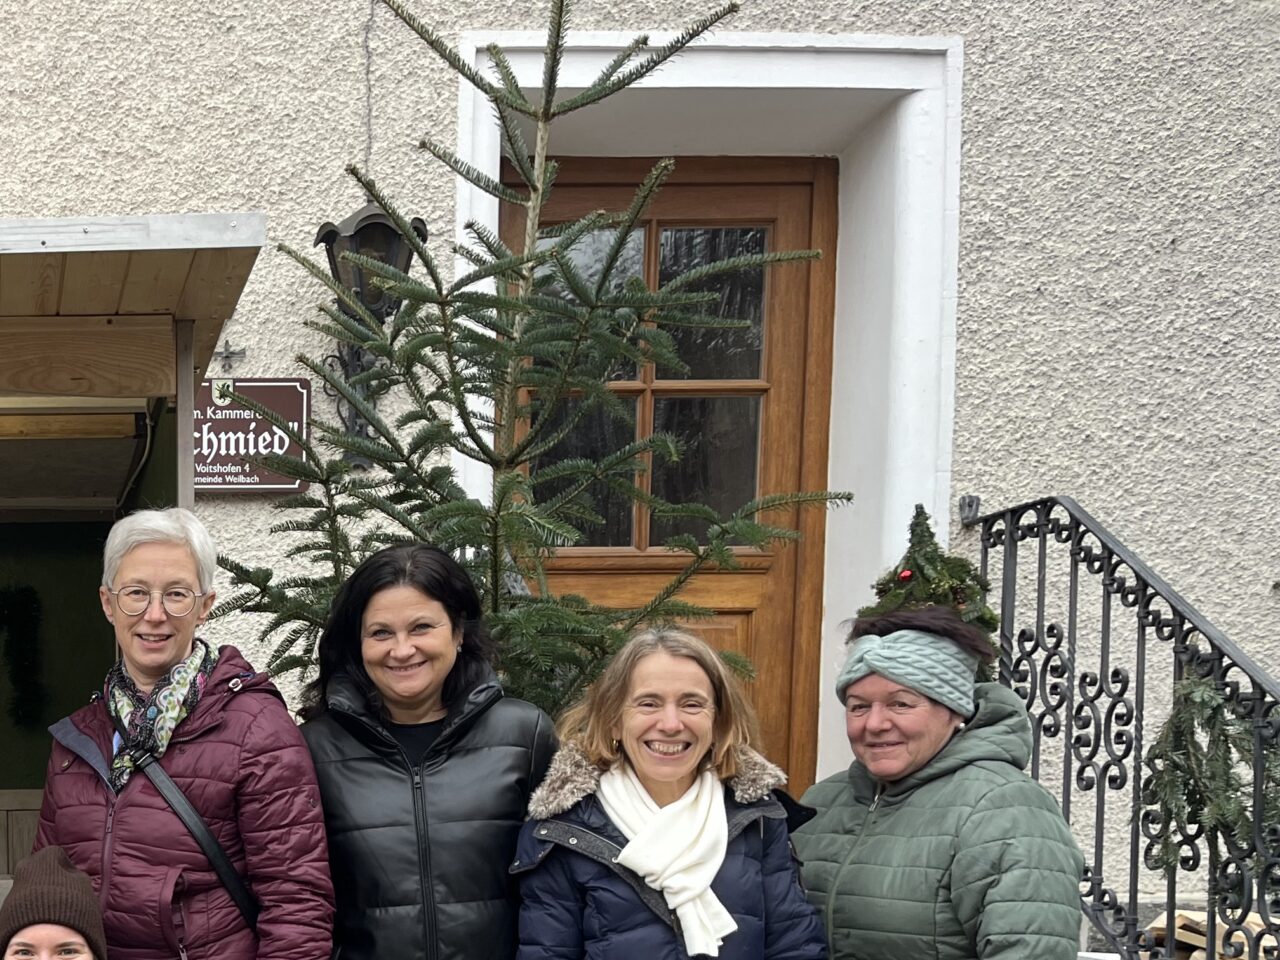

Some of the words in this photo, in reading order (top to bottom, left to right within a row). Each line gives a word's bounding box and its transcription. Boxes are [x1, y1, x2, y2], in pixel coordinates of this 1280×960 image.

[193, 422, 298, 464] chmied"
[195, 462, 242, 473] Voitshofen
[243, 462, 250, 473] 4
[194, 475, 223, 484] meinde
[224, 475, 260, 484] Weilbach
